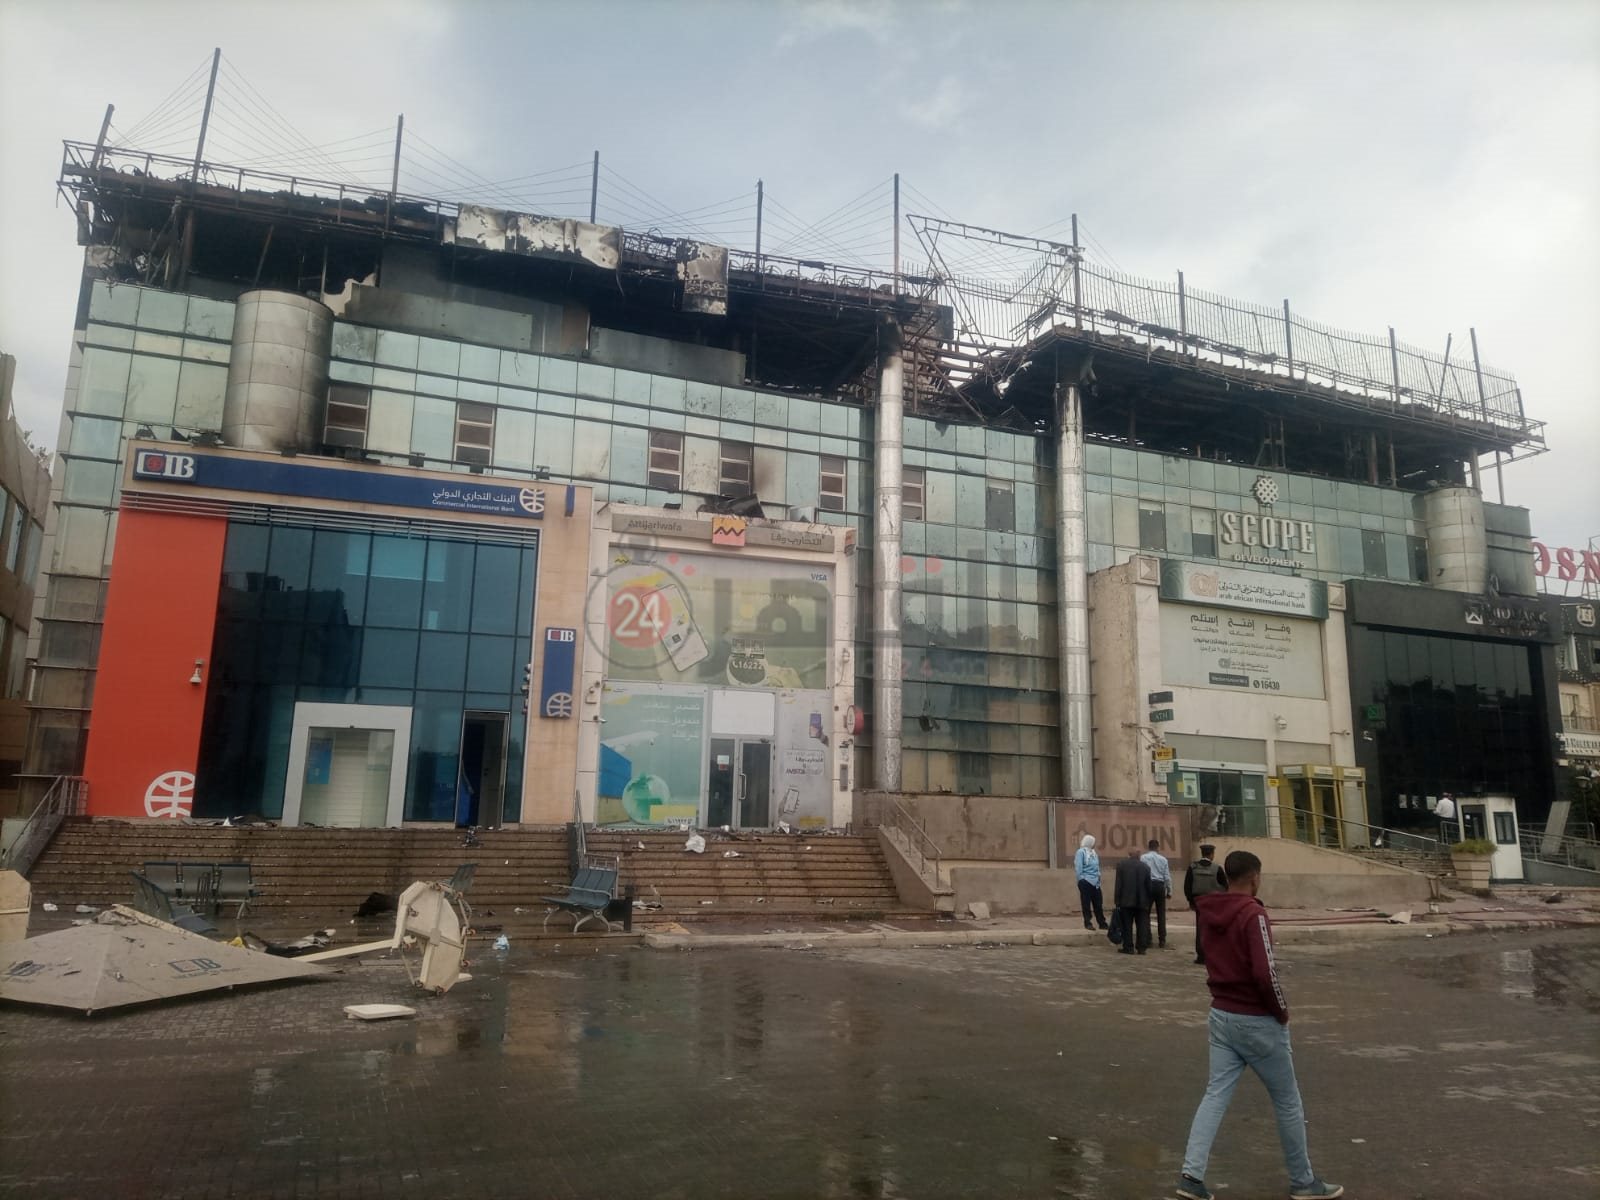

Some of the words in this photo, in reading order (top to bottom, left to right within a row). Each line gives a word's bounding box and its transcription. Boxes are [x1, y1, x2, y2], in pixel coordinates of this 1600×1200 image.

[137, 451, 194, 478] CIB
[432, 499, 465, 508] Commercial
[467, 503, 500, 511] International
[493, 494, 515, 503] البنك
[1222, 511, 1315, 553] SCOPE
[1234, 554, 1305, 569] DEVELOPMENTS
[810, 573, 827, 582] VISA
[1234, 594, 1253, 602] african
[1255, 597, 1291, 607] international
[1291, 601, 1306, 609] bank
[547, 629, 574, 642] CIB
